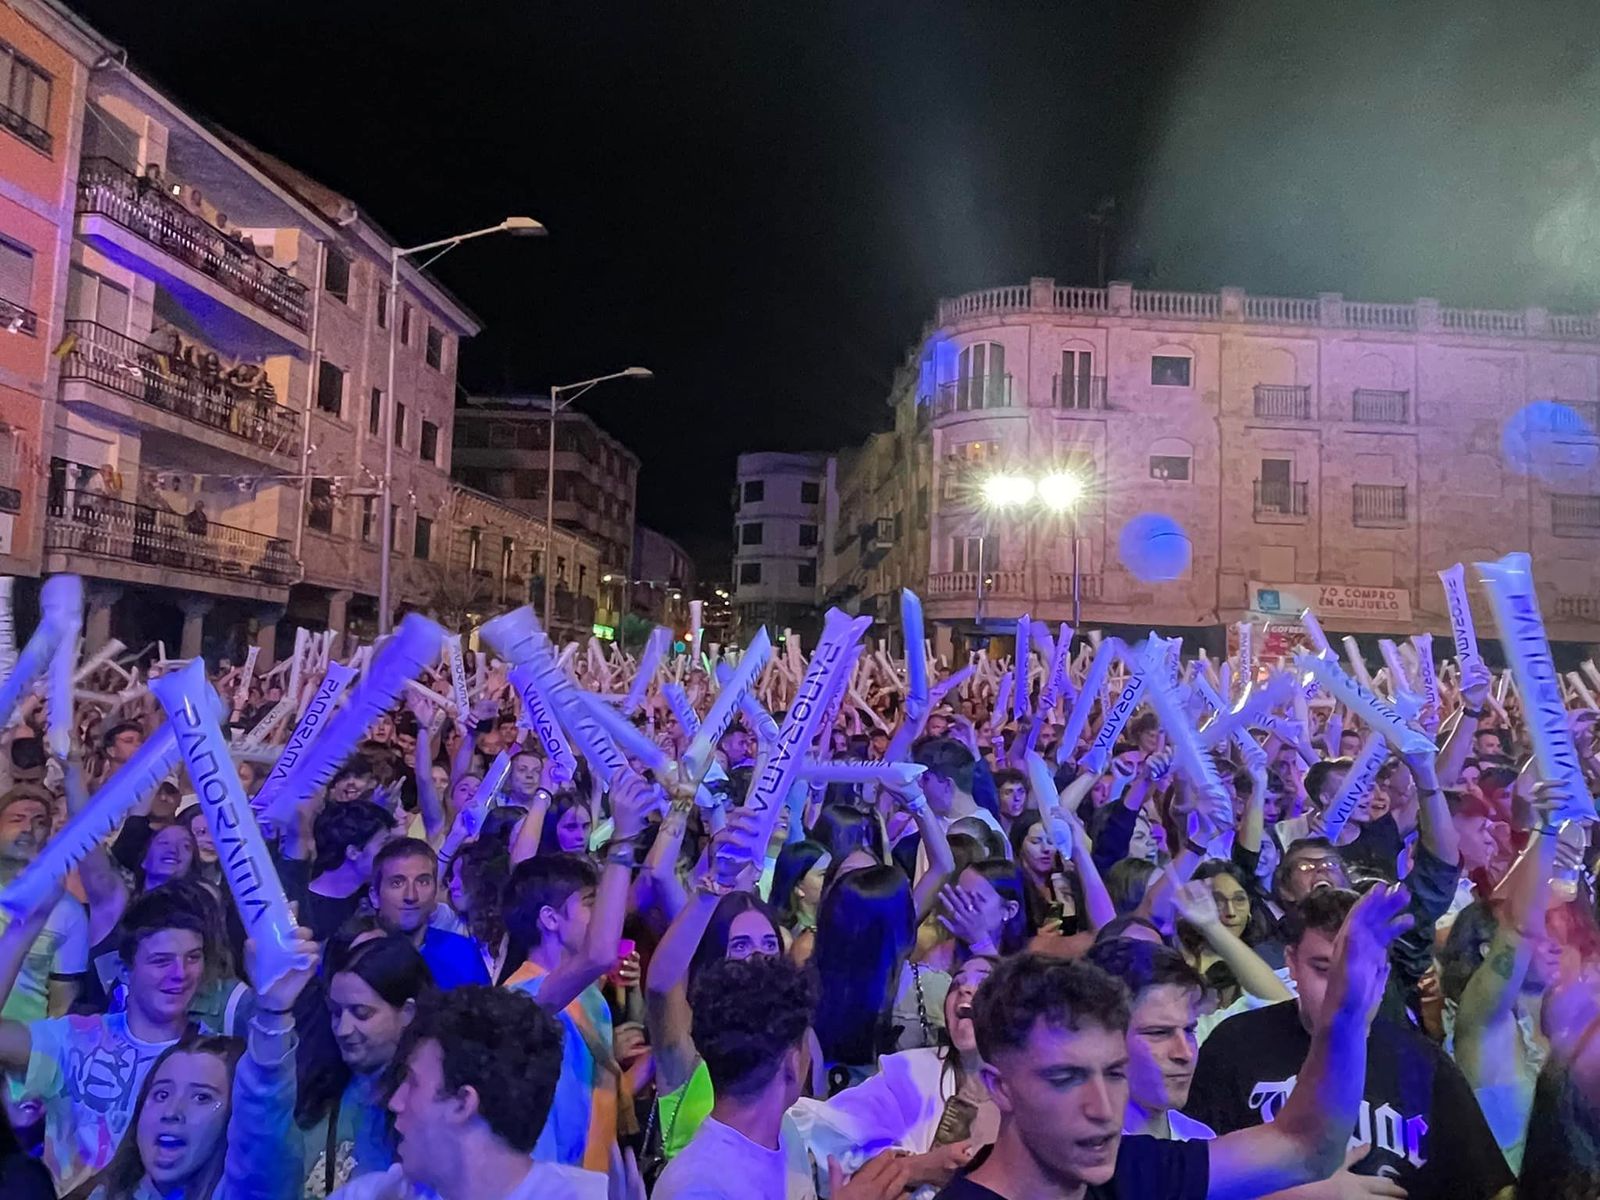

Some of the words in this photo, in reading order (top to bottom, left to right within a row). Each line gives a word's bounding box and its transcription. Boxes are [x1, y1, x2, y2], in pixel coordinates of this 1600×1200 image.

[1319, 597, 1334, 607] EN
[1337, 598, 1399, 610] GUIJUELO
[1320, 587, 1338, 597] YO
[1344, 588, 1396, 600] COMPRO
[271, 679, 339, 779] PANORAMA
[748, 642, 840, 811] PANORAMA
[174, 701, 272, 924] PANORAMA
